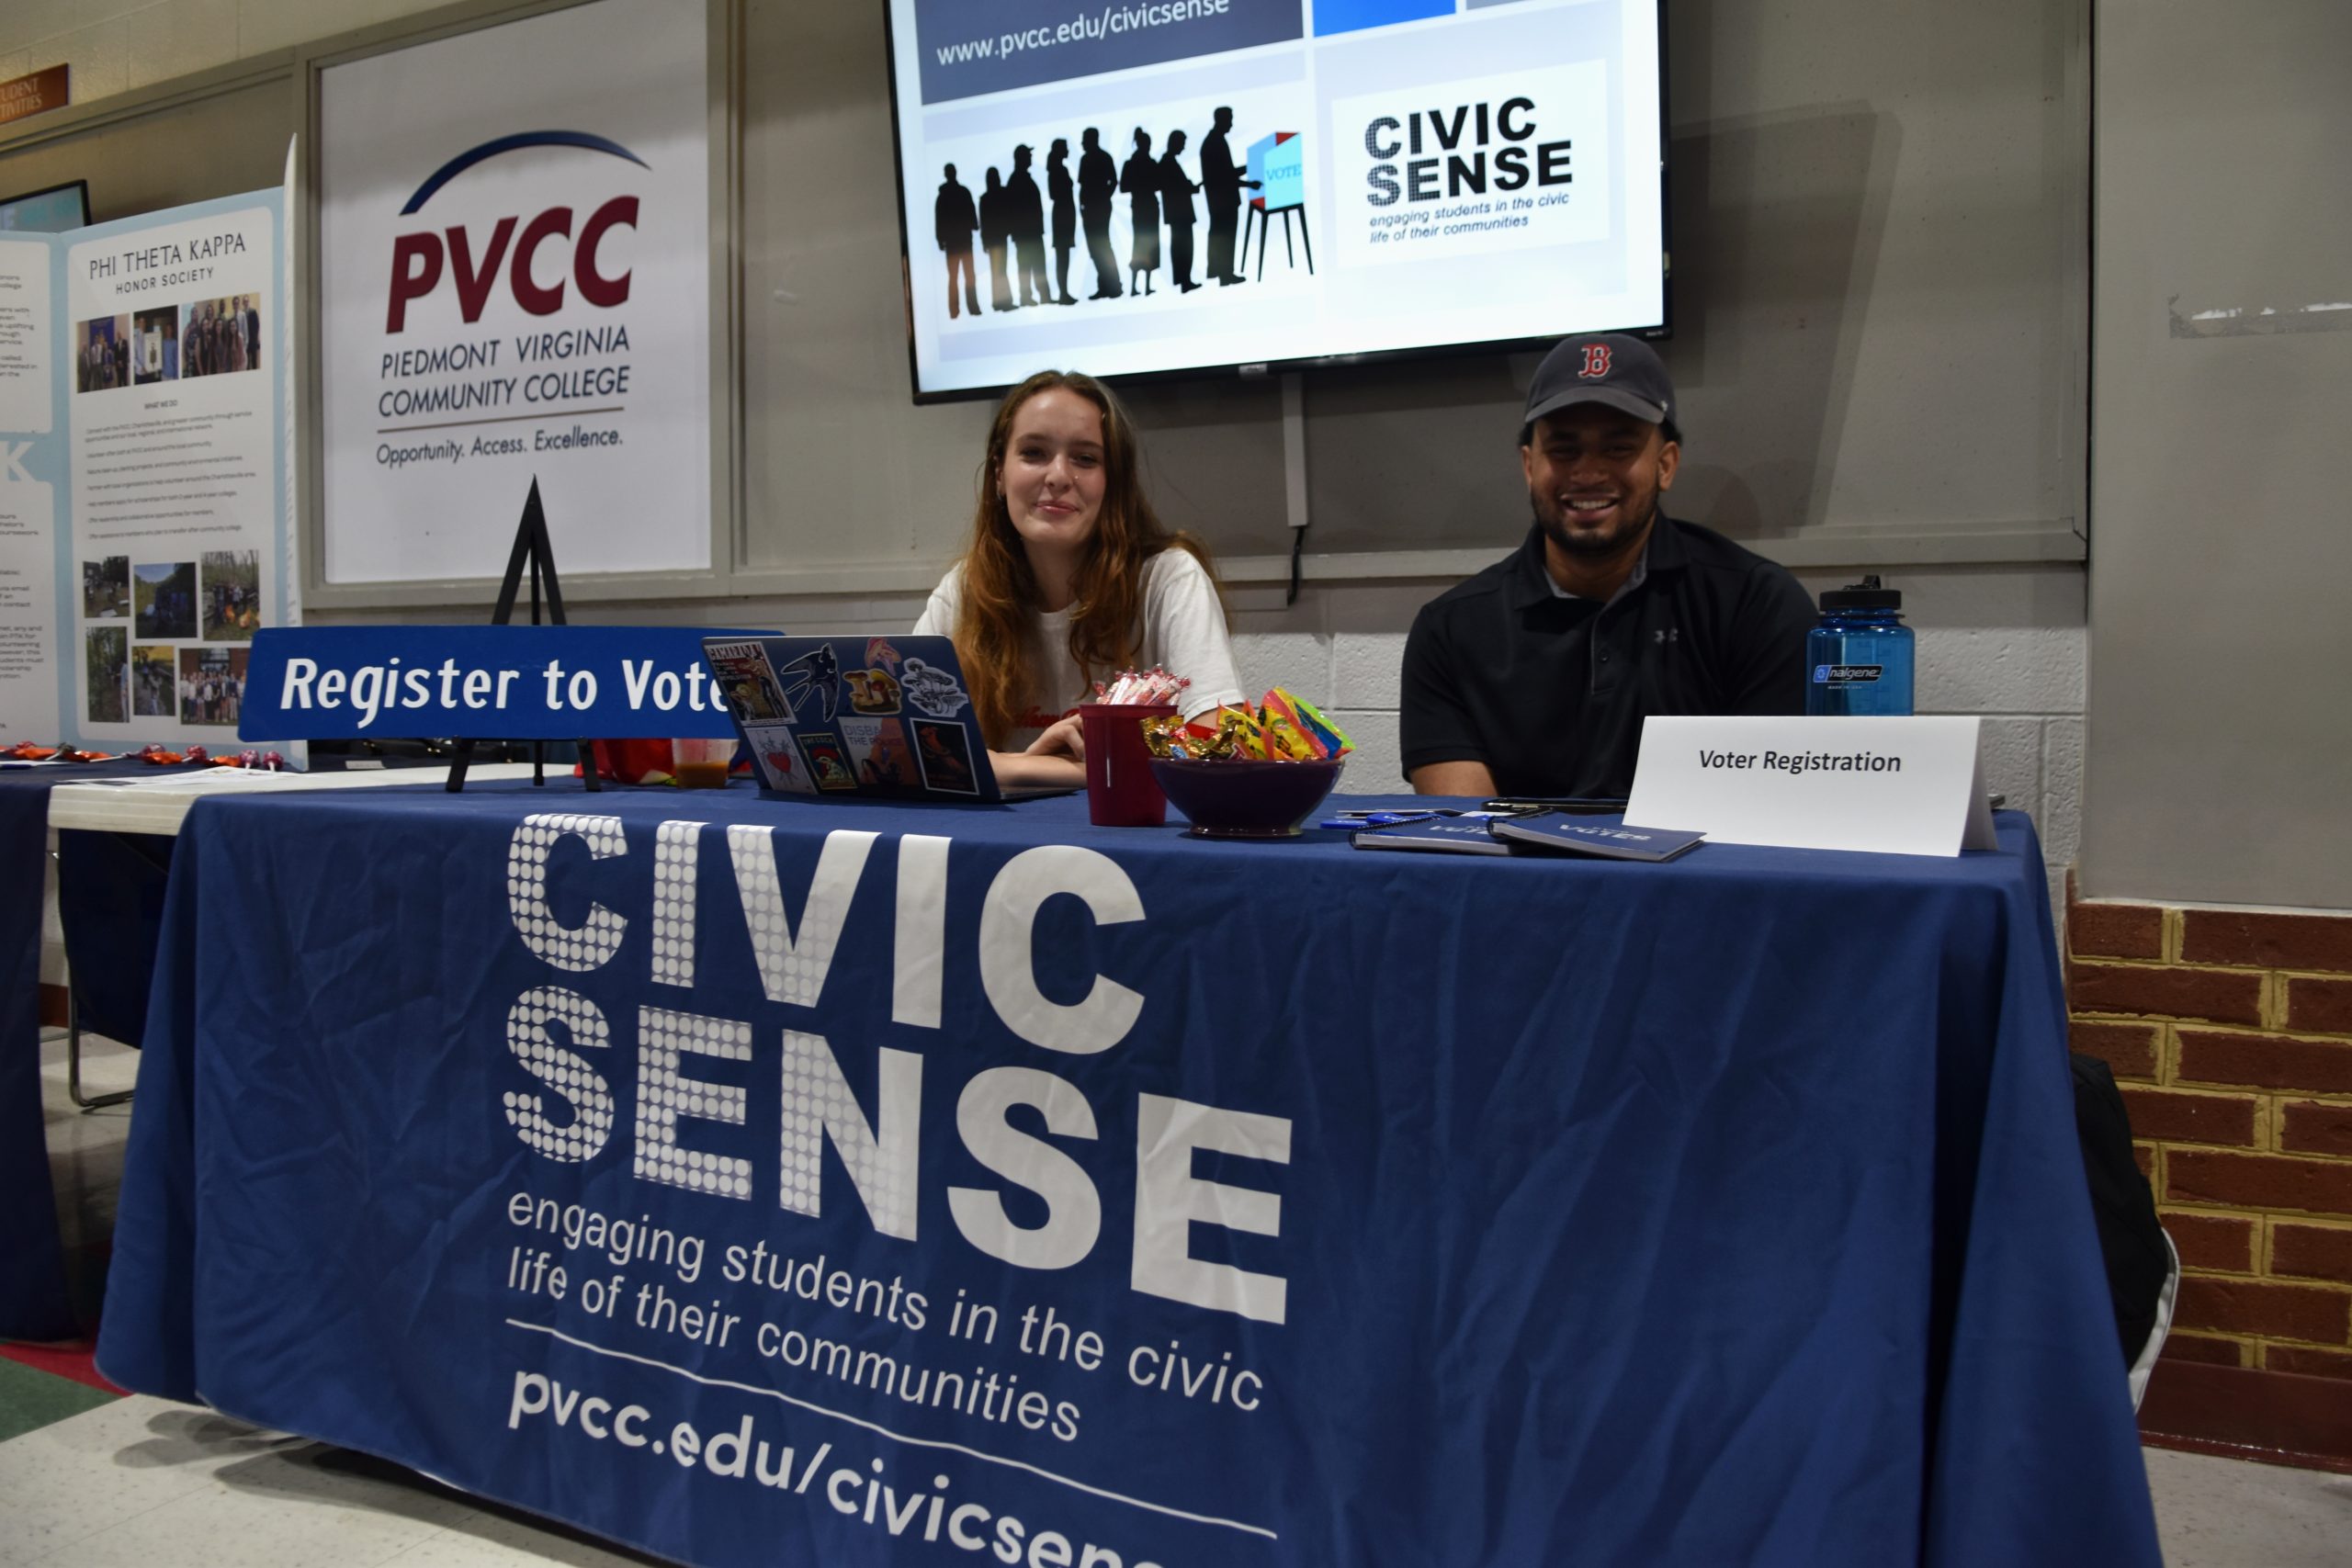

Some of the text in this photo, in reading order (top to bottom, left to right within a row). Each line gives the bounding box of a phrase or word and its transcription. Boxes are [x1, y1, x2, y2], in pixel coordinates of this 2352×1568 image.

[936, 0, 1229, 66] www.pvcc.edu/civicsense
[1364, 96, 1537, 160] CIVIC
[1266, 164, 1302, 183] VOTE
[1367, 140, 1572, 207] SENSE
[1370, 192, 1569, 228] engaging students in the civic
[1370, 215, 1529, 243] life of their communities
[90, 232, 246, 280] PHI THETA KAPPA
[116, 267, 215, 295] HONOR SOCIETY
[386, 195, 639, 334] PVCC
[382, 325, 630, 379] PIEDMONT VIRGINIA
[1577, 343, 1612, 378] B
[379, 365, 630, 417] COMMUNITY COLLEGE
[0, 441, 35, 481] K
[377, 426, 623, 468] Opportunity. Access. Excellence.
[280, 657, 520, 729] Register
[543, 659, 598, 711] to
[1829, 667, 1881, 681] nalgene
[1699, 749, 1902, 775] Voter Registration
[507, 814, 1147, 1055] CIVIC
[503, 985, 1293, 1325] SENSE
[508, 1191, 1263, 1411] engaging students in the civic
[508, 1247, 1081, 1441] life of their communities
[508, 1371, 1165, 1568] pvcc.edu/civicsen
